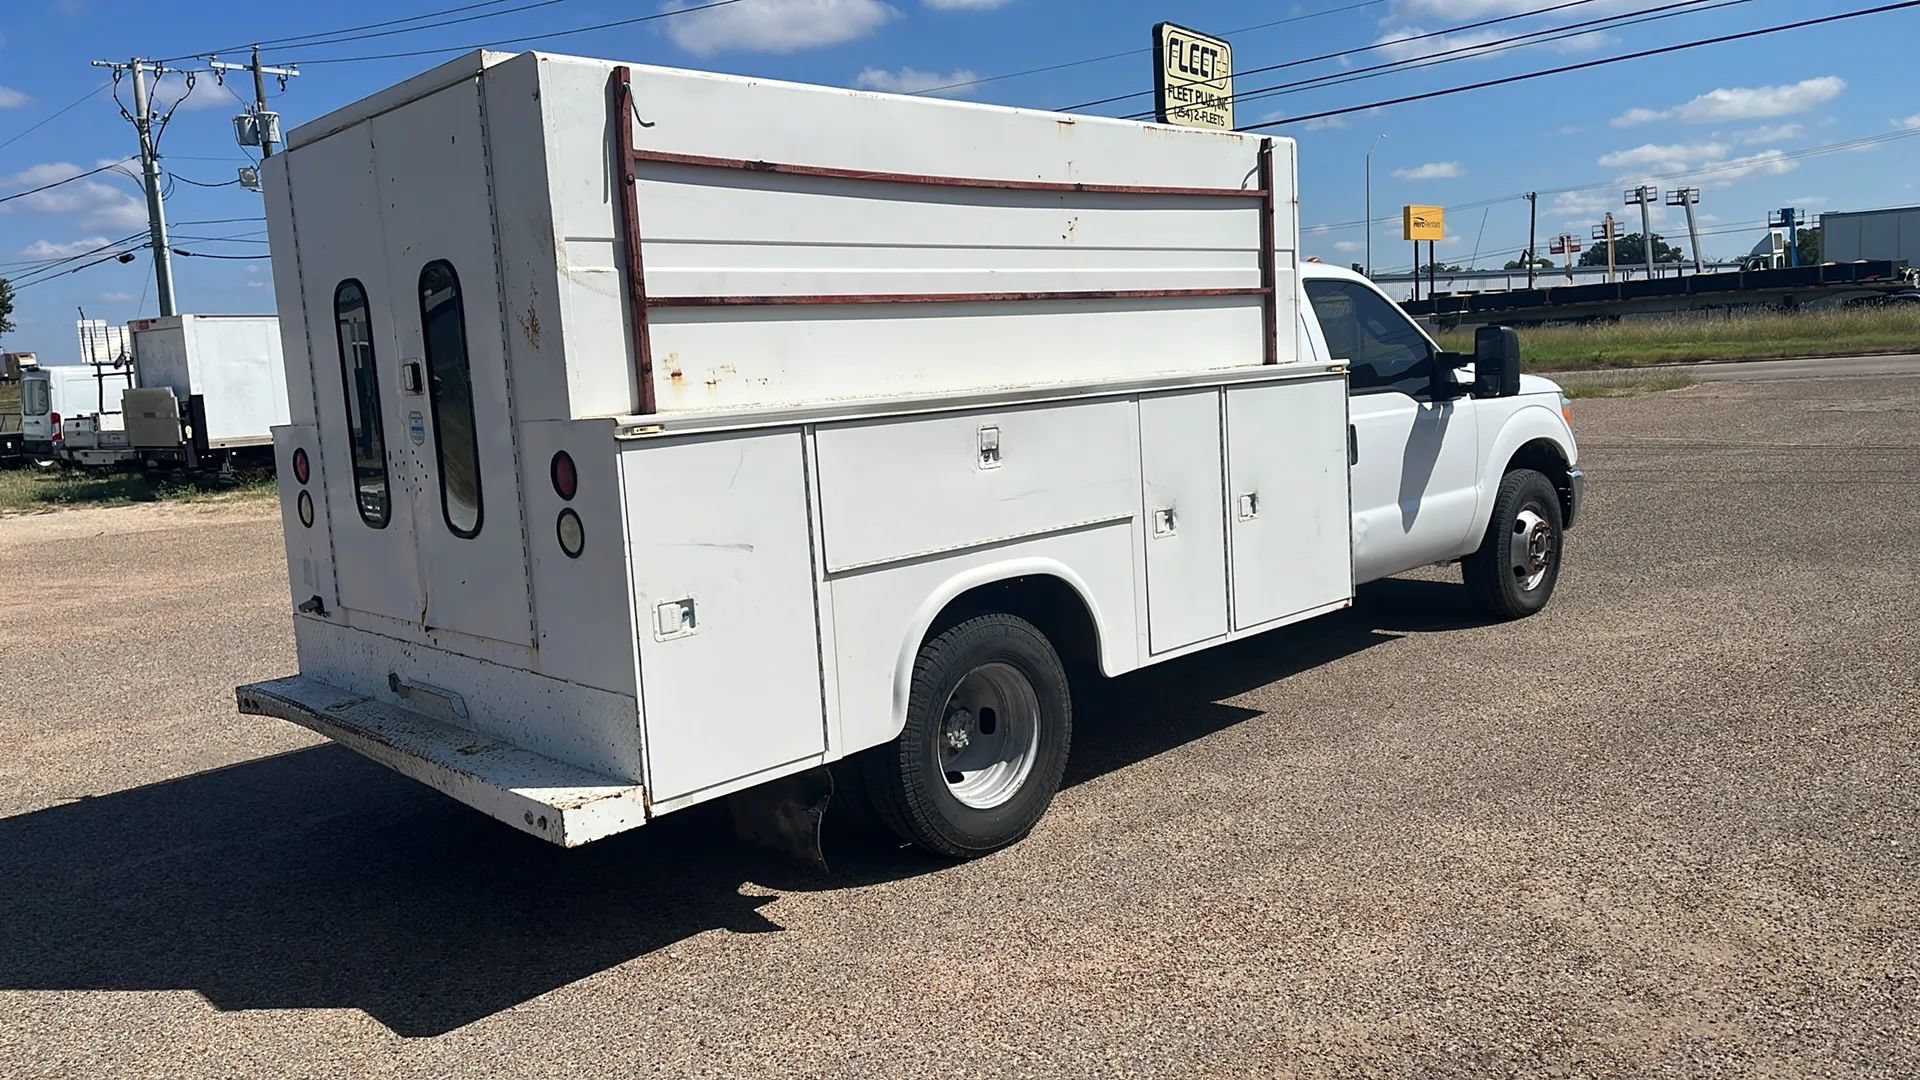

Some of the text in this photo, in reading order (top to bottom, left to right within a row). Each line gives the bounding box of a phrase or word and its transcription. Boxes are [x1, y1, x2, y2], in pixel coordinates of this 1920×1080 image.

[1169, 38, 1218, 80] FLEET
[1168, 84, 1194, 103] FLEET
[1174, 105, 1225, 127] (254) 2-FLEETS
